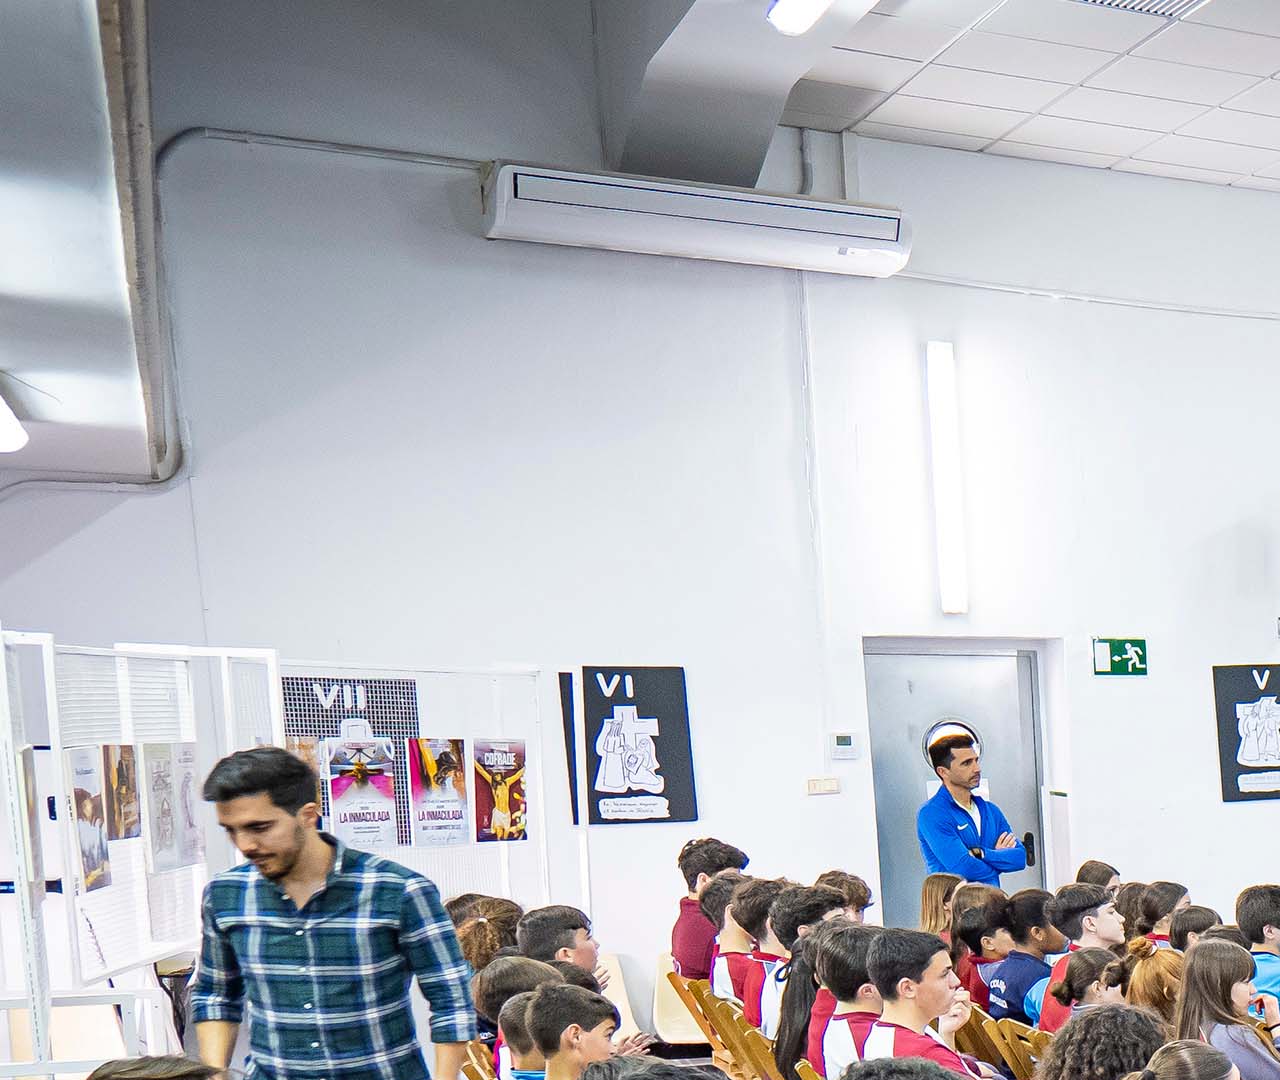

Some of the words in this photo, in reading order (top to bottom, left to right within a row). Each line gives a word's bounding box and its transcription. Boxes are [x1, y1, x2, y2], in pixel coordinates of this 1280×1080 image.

[595, 672, 634, 698] VI
[1252, 669, 1270, 691] V
[313, 683, 367, 710] VII
[339, 811, 349, 823] LA
[349, 810, 391, 823] INMACULADA
[418, 810, 426, 821] LA
[426, 809, 464, 822] INMACULADA
